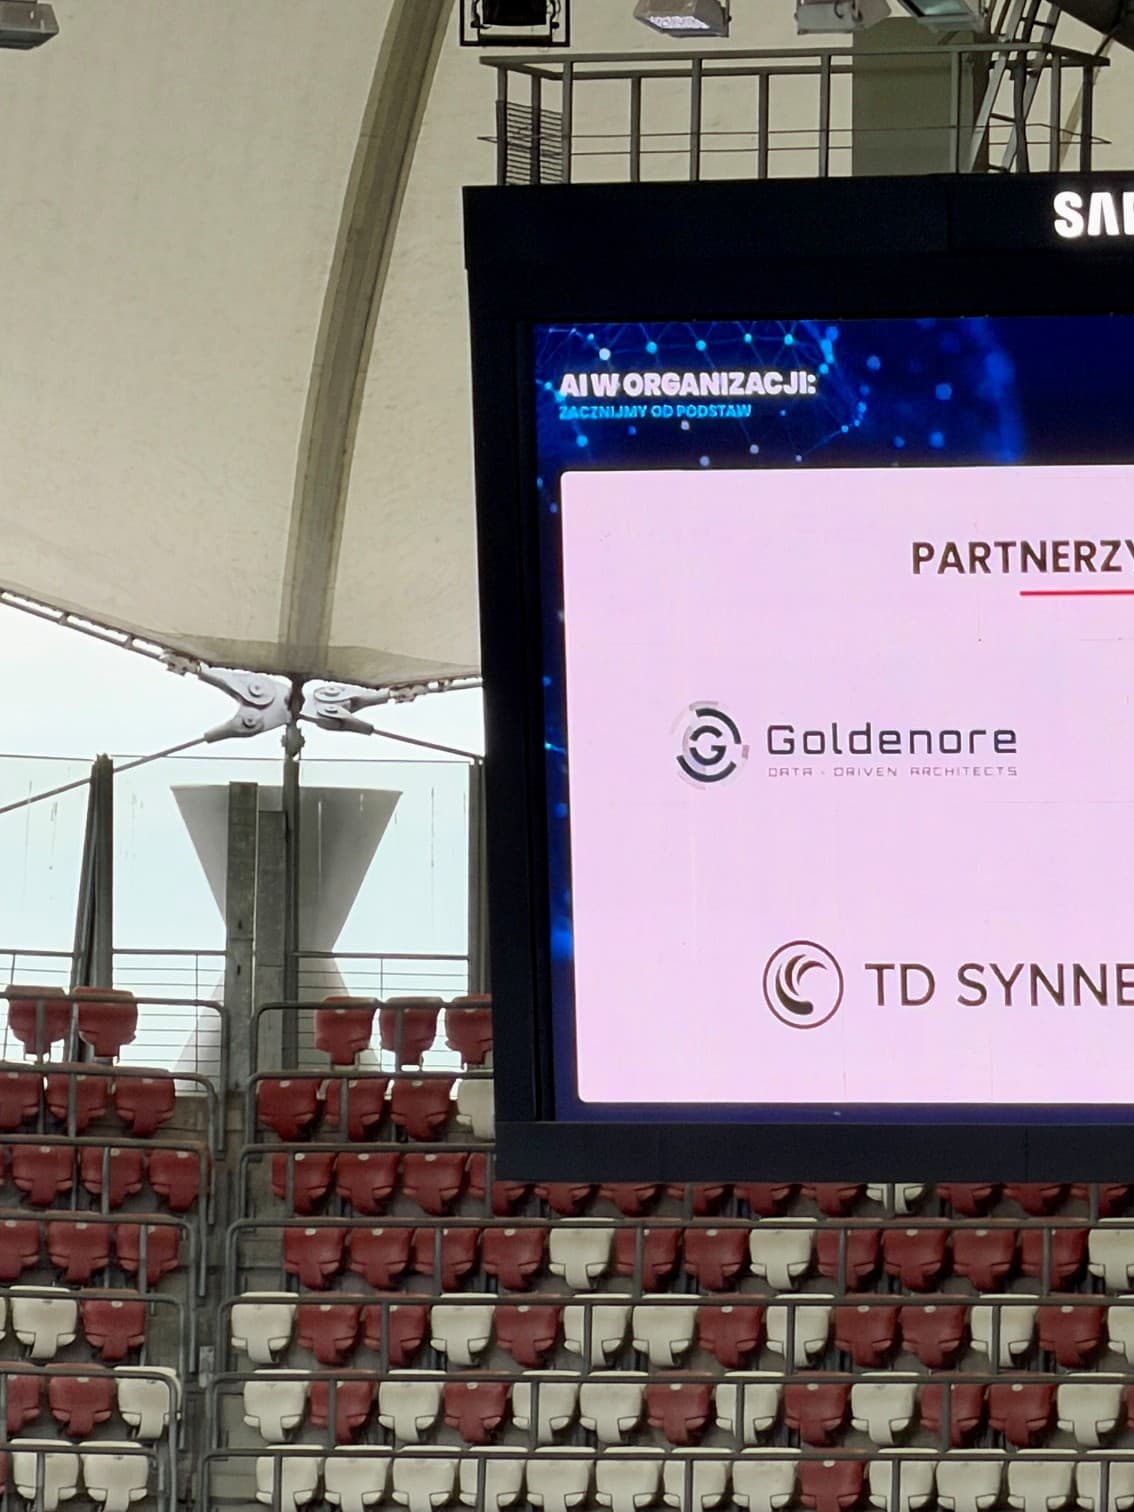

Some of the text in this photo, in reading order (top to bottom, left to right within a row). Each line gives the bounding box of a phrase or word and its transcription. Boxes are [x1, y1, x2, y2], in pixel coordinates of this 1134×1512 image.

[559, 371, 817, 397] AI W ORGANIZACJI:
[559, 404, 752, 421] ZACZNIJMY OD PODSTAW
[767, 721, 1017, 755] Goldenore
[768, 766, 813, 778] DATA
[833, 766, 898, 778] DRIVEN
[909, 765, 1018, 778] ARCHITECTS
[864, 963, 936, 1007] TD
